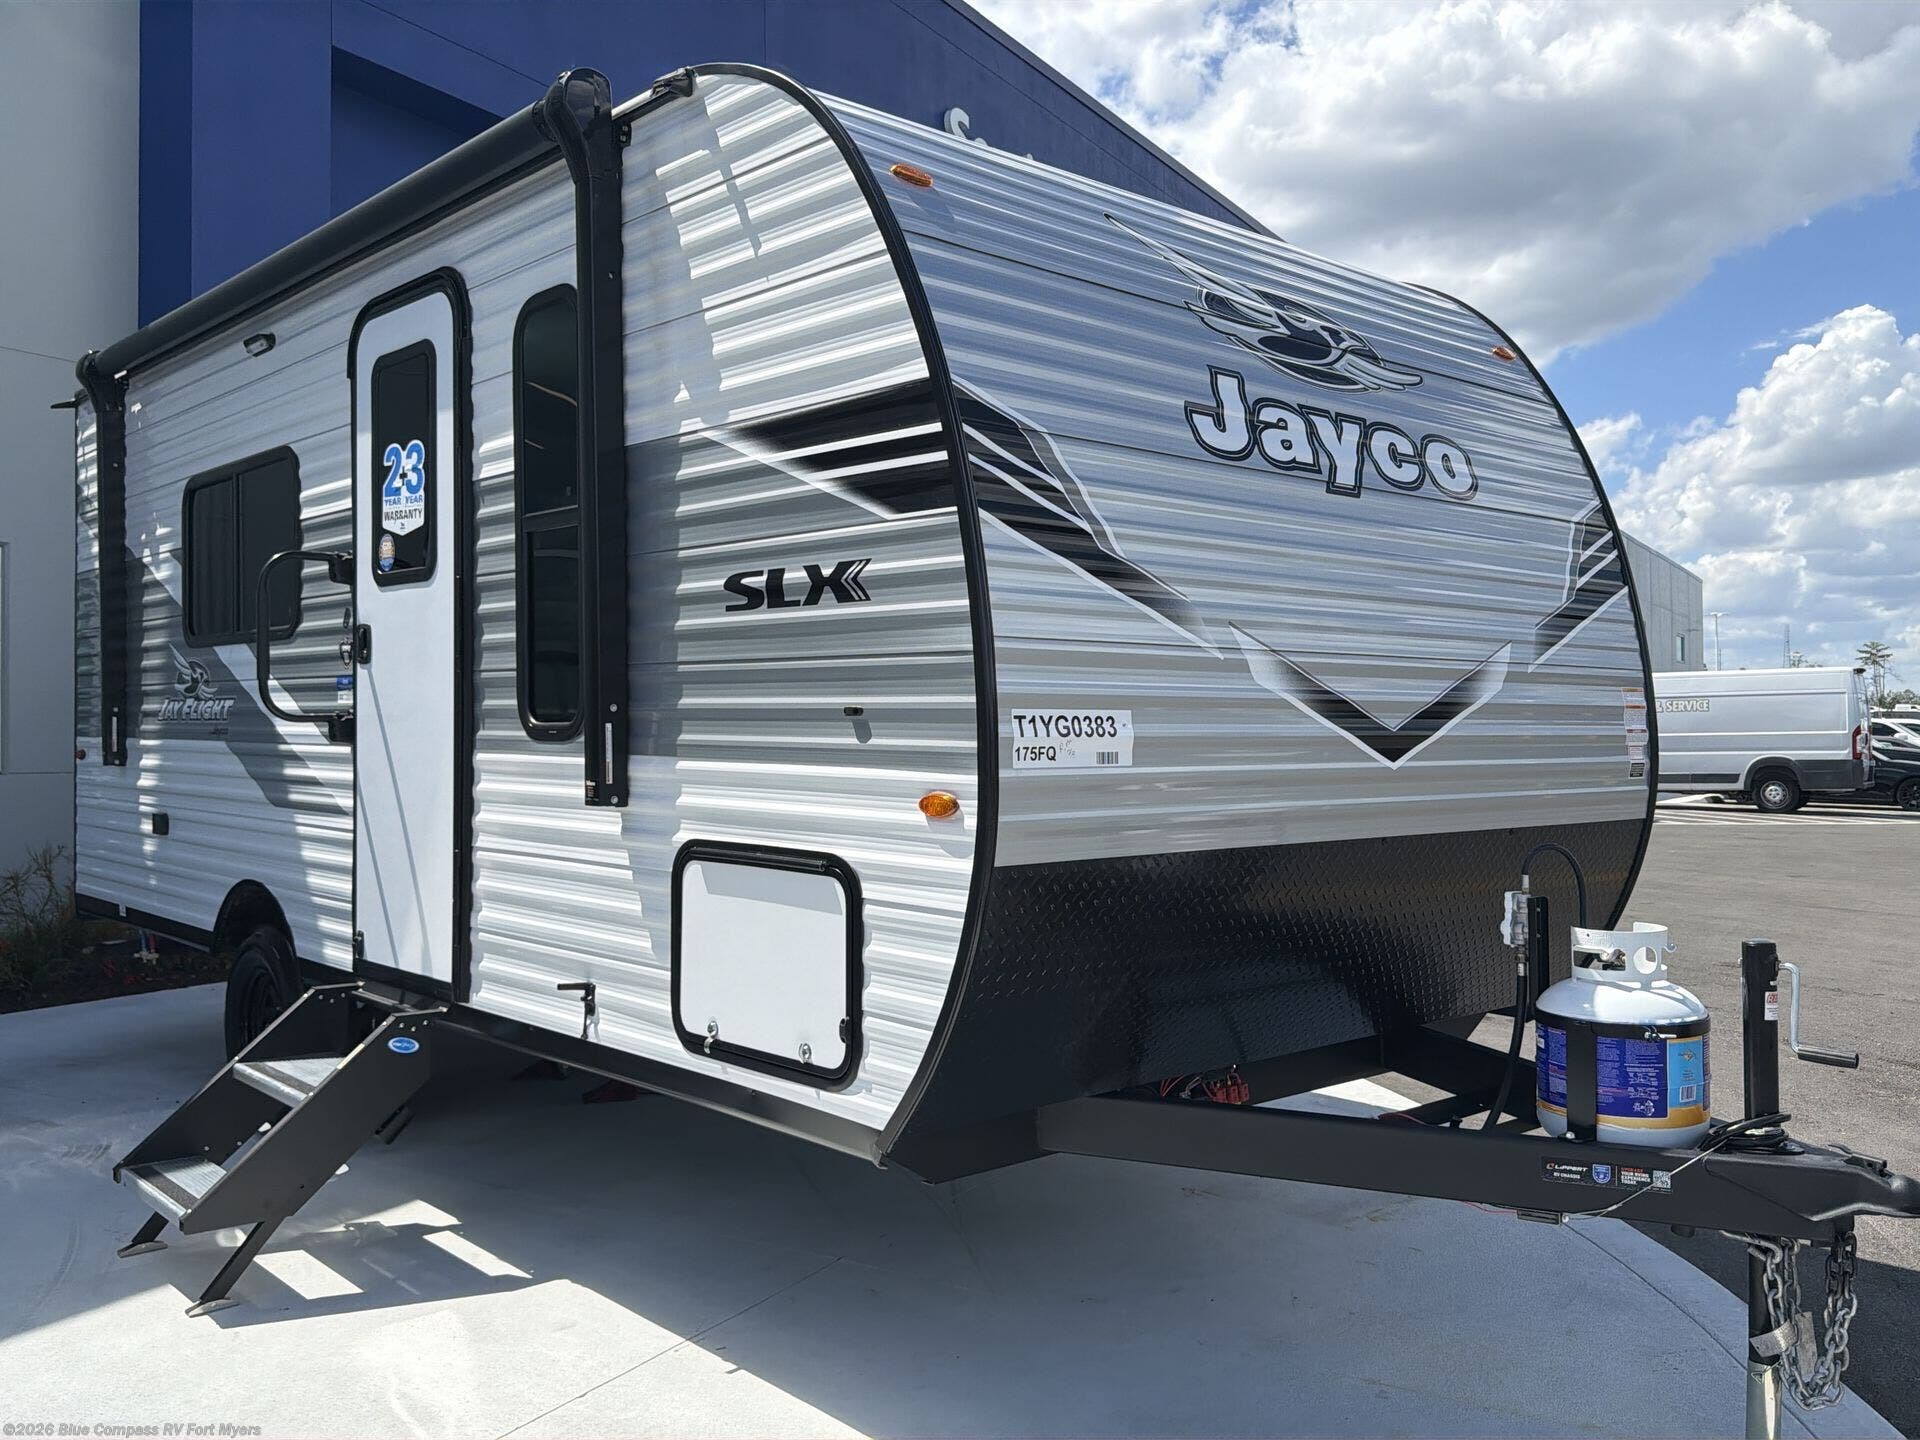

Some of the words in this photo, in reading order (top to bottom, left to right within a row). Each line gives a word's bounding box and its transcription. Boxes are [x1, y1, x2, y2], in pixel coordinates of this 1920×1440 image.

[1184, 364, 1479, 500] Jayco
[384, 497, 402, 506] YEAR
[405, 494, 423, 504] YEAR
[384, 508, 422, 521] WARRANTY
[723, 558, 872, 612] SLX
[158, 698, 184, 721] JAY
[182, 697, 235, 721] FLIGHT
[1666, 699, 1710, 712] SERVICE
[1013, 715, 1117, 738] T1YG0383
[1015, 746, 1056, 762] 175FQ
